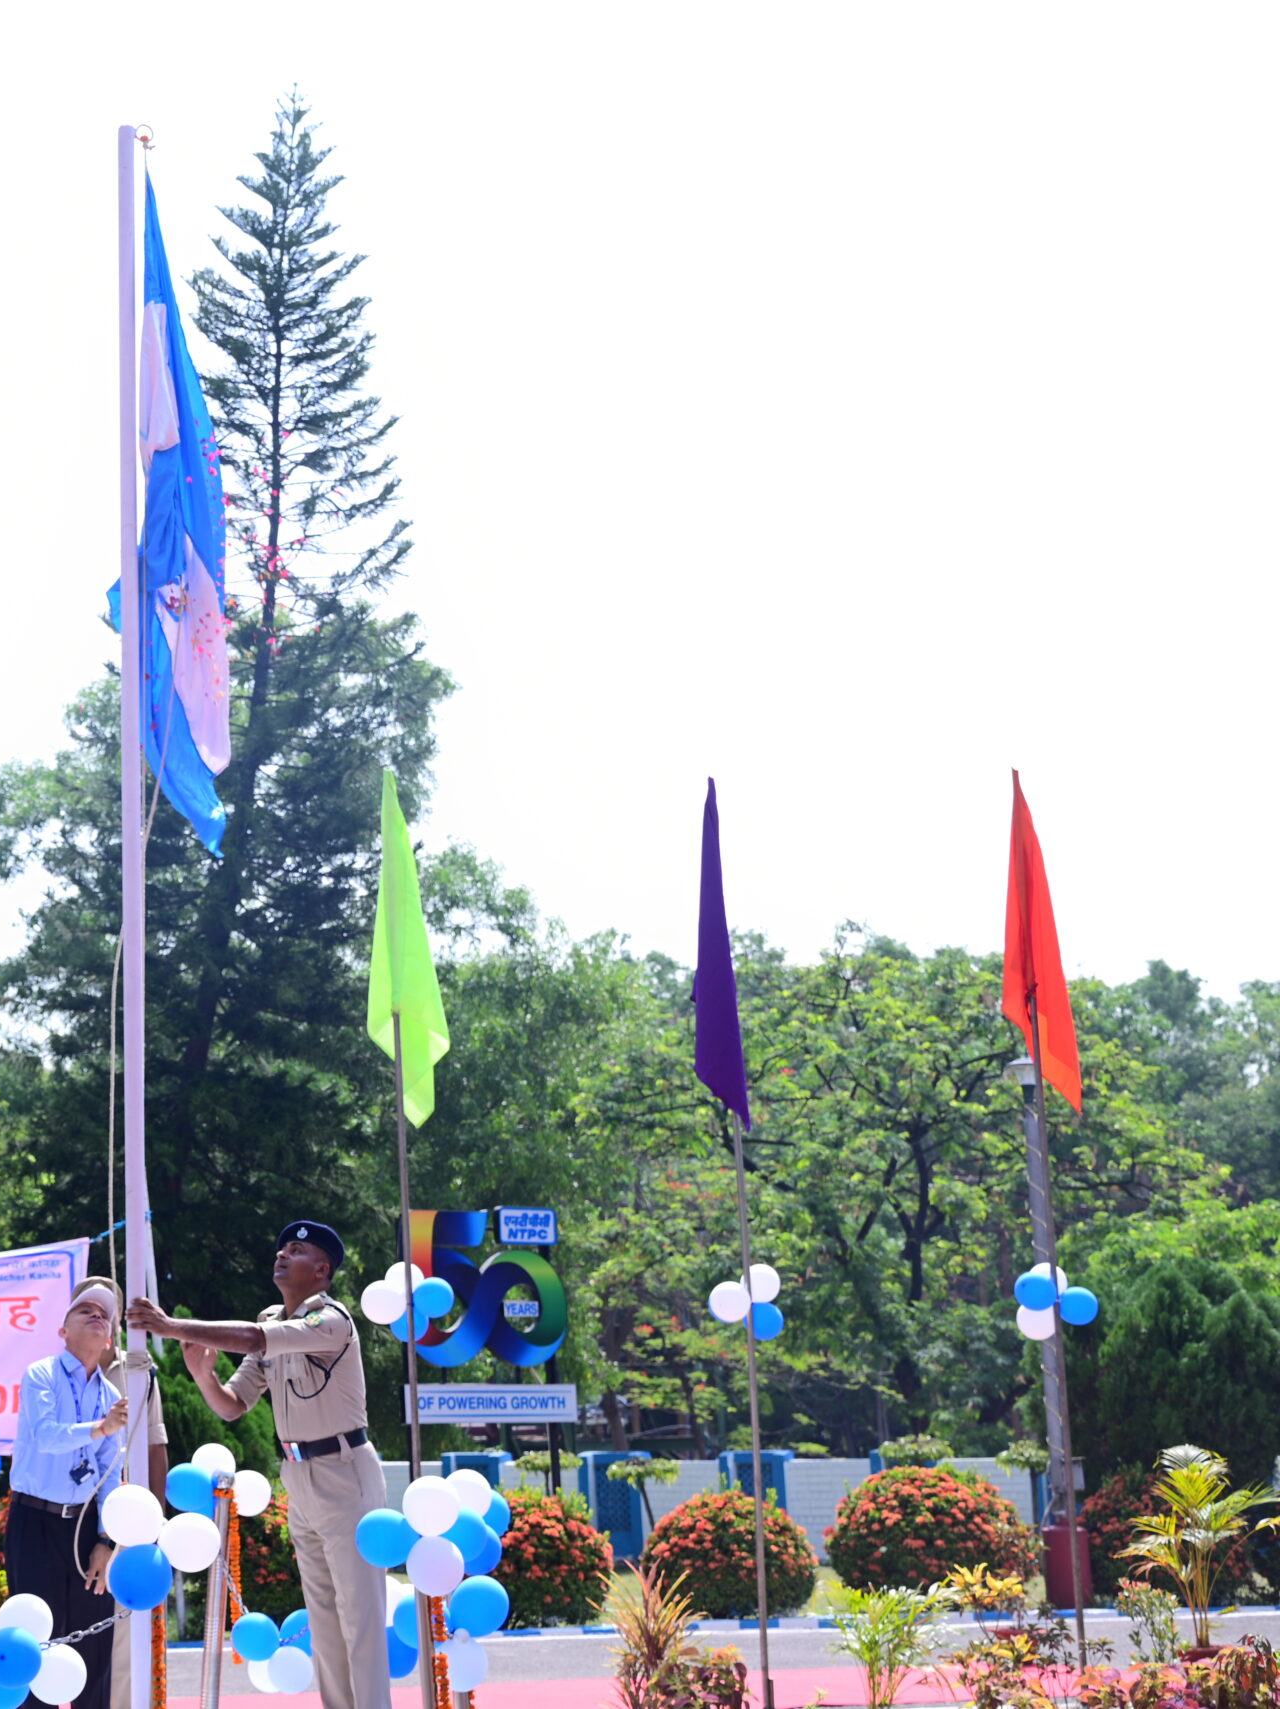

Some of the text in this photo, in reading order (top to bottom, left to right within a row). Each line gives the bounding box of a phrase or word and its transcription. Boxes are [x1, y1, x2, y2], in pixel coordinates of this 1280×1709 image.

[508, 1228, 549, 1240] NTPC
[505, 1303, 538, 1316] YEARS
[417, 1395, 566, 1411] OF POWERING GROWTH
